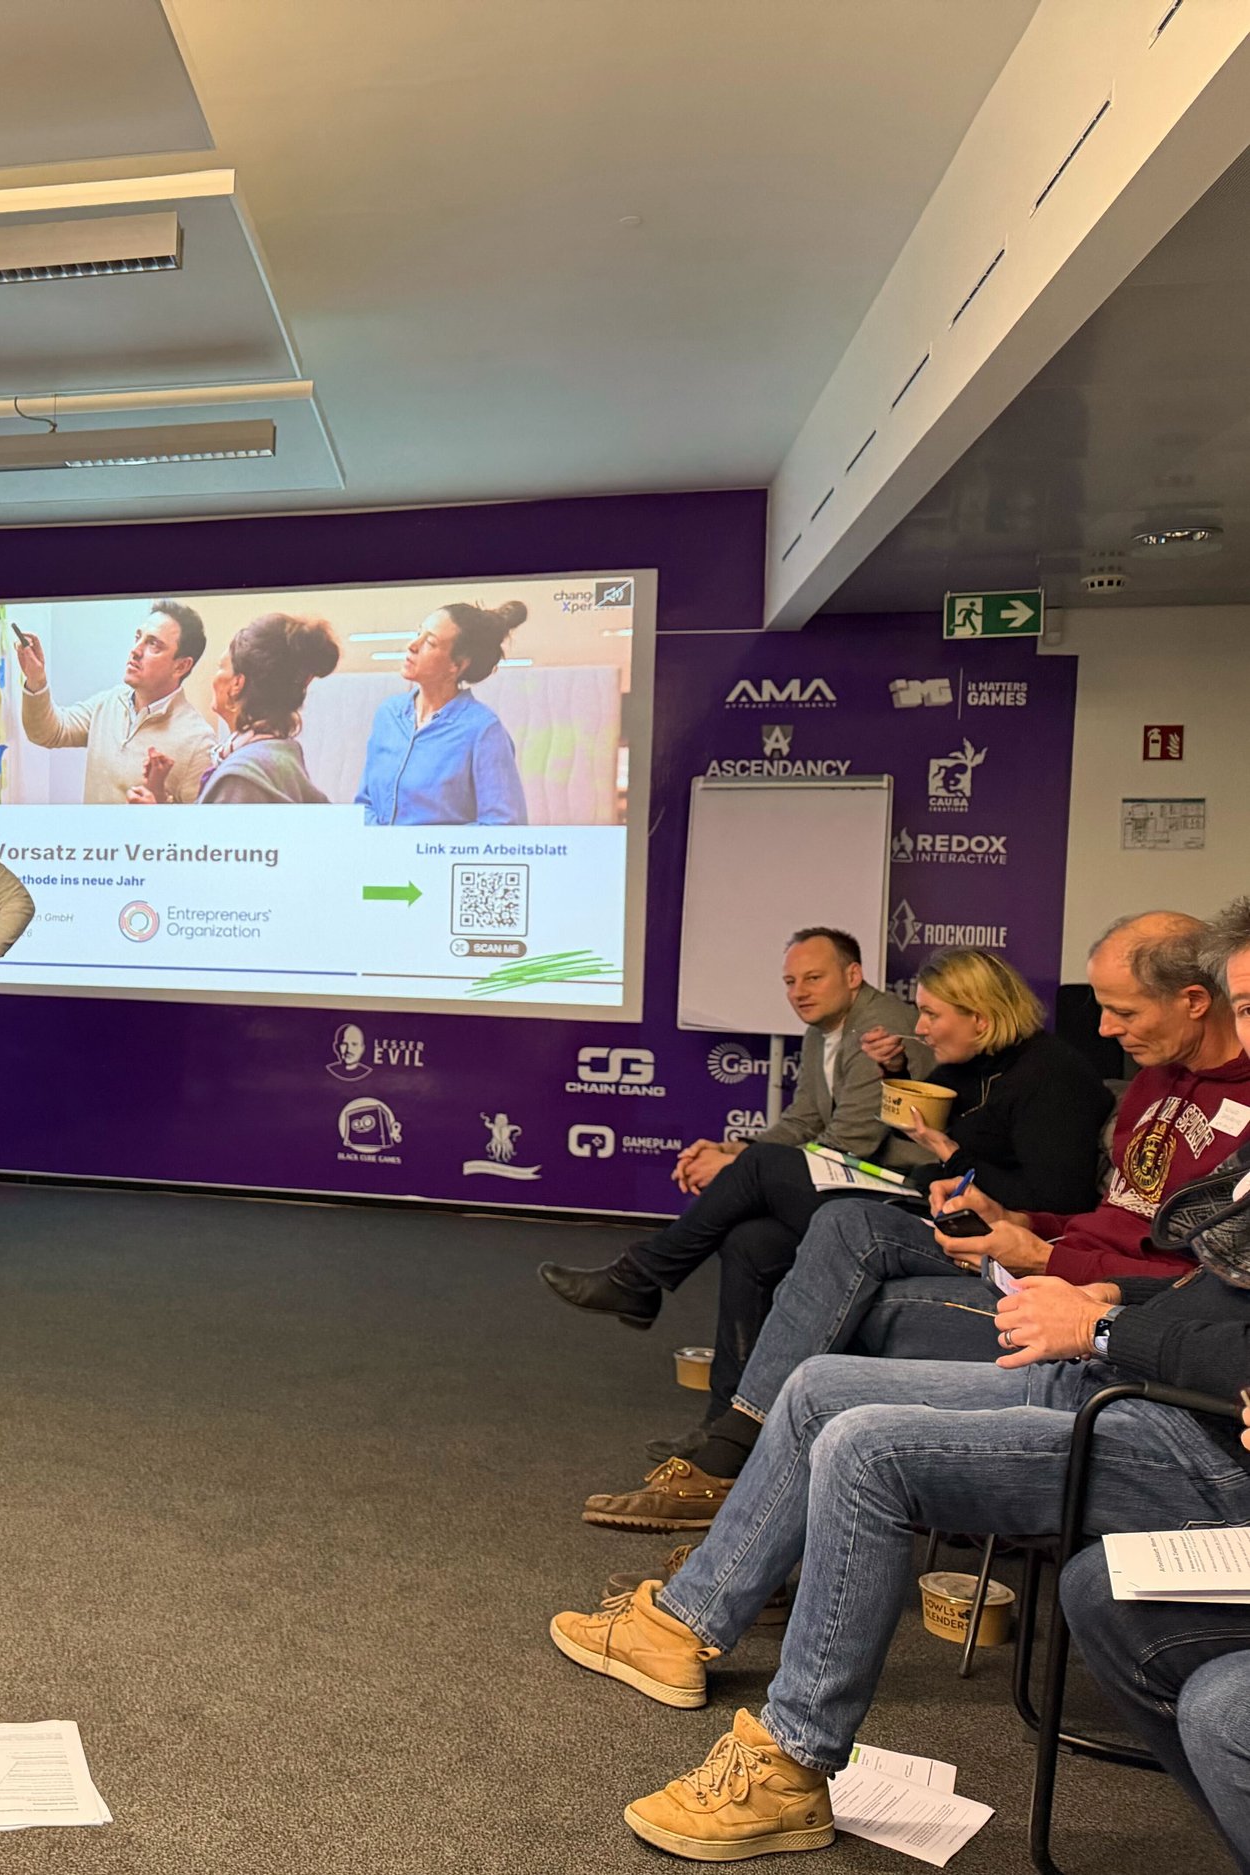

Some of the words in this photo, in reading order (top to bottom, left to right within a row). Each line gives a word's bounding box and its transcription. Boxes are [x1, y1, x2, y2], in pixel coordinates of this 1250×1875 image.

[553, 590, 593, 602] chang
[725, 678, 837, 702] AMA
[978, 682, 1028, 693] MATTERS
[967, 692, 1027, 706] GAMES
[706, 759, 851, 777] ASCENDANCY
[416, 843, 445, 855] Link
[450, 846, 480, 855] zum
[483, 844, 567, 856] Arbeitsblatt
[917, 834, 1007, 853] REDOX
[83, 848, 119, 861] zur
[125, 843, 279, 867] Veränderung
[916, 852, 1007, 865] INTERACTIVE
[60, 874, 79, 885] ins
[82, 877, 113, 886] neue
[116, 875, 146, 886] Jahr
[166, 922, 261, 940] Organization
[924, 924, 1007, 948] ROCKODILE
[473, 943, 500, 953] SCAN
[503, 943, 520, 954] ME
[374, 1039, 425, 1051] LESSER
[373, 1048, 424, 1067] EVIL
[722, 1053, 801, 1081] Gamfy
[565, 1082, 616, 1094] CHAIN
[618, 1085, 666, 1097] GANG
